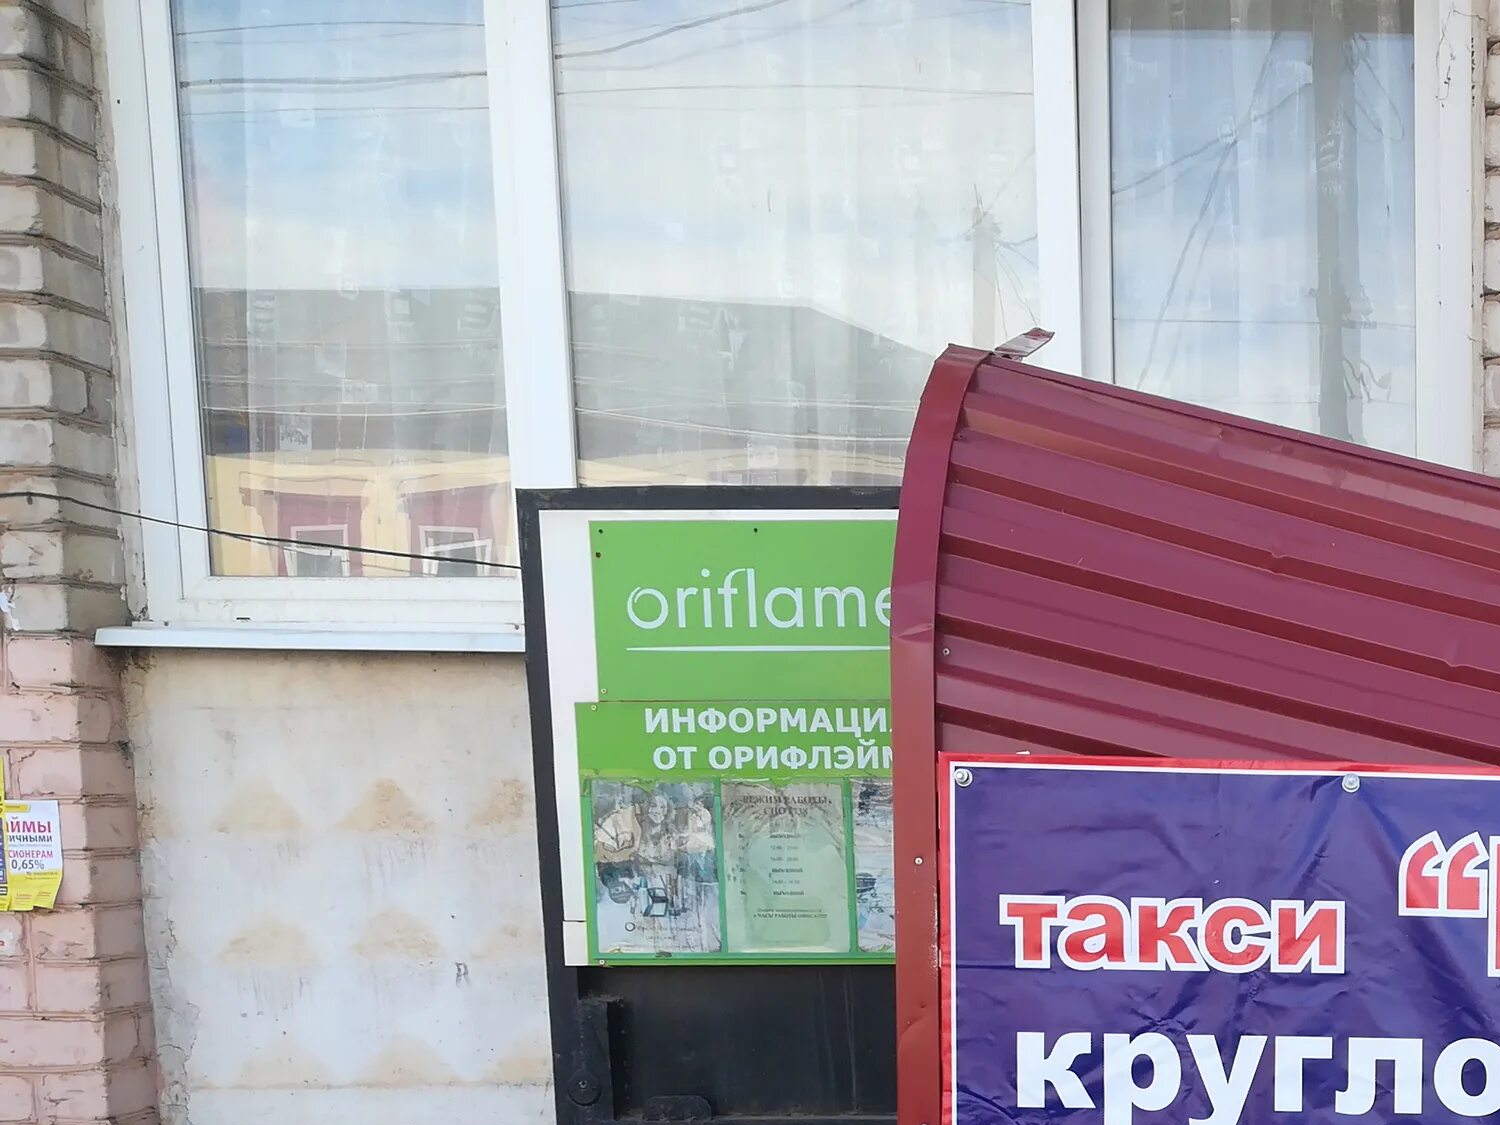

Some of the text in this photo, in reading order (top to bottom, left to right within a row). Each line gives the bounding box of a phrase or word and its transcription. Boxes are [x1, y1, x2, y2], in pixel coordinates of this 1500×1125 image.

[644, 707, 892, 738] ИНФОРМАЦИ
[653, 738, 893, 770] ОТ ОРИФЛЭЙ
[6, 816, 52, 833] ймы
[8, 850, 54, 858] СИОНЕРАМ
[11, 859, 45, 870] 0,65%
[999, 894, 1346, 974] такси
